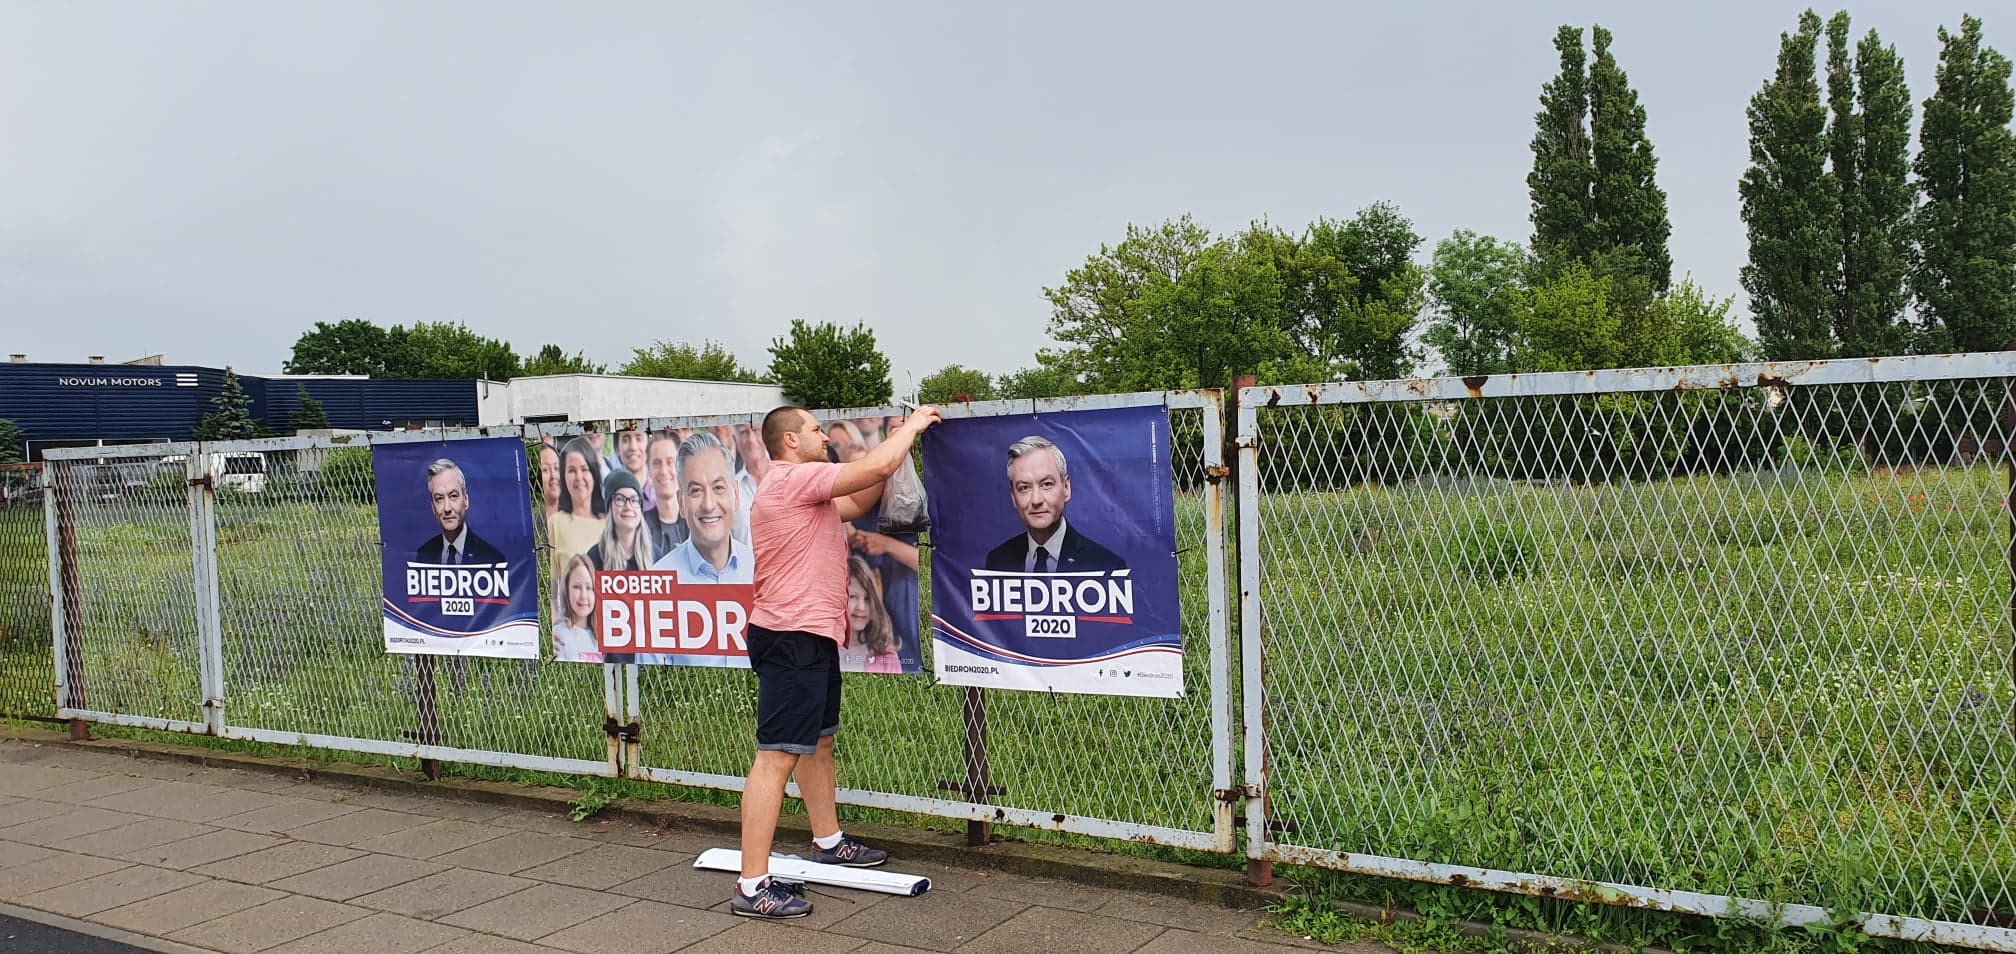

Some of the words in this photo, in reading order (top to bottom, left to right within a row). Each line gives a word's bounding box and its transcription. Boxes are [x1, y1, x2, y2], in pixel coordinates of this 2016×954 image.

[59, 378, 107, 386] NOVUM
[111, 378, 162, 387] MOTORS
[406, 562, 510, 598] BIEDROŃ
[601, 575, 674, 594] ROBERT
[970, 569, 1134, 614] BIEDROŃ
[445, 601, 471, 613] 2020
[602, 599, 749, 651] BIEDR
[1031, 619, 1071, 634] 2020
[945, 664, 1000, 674] BIEDRON2020.PL
